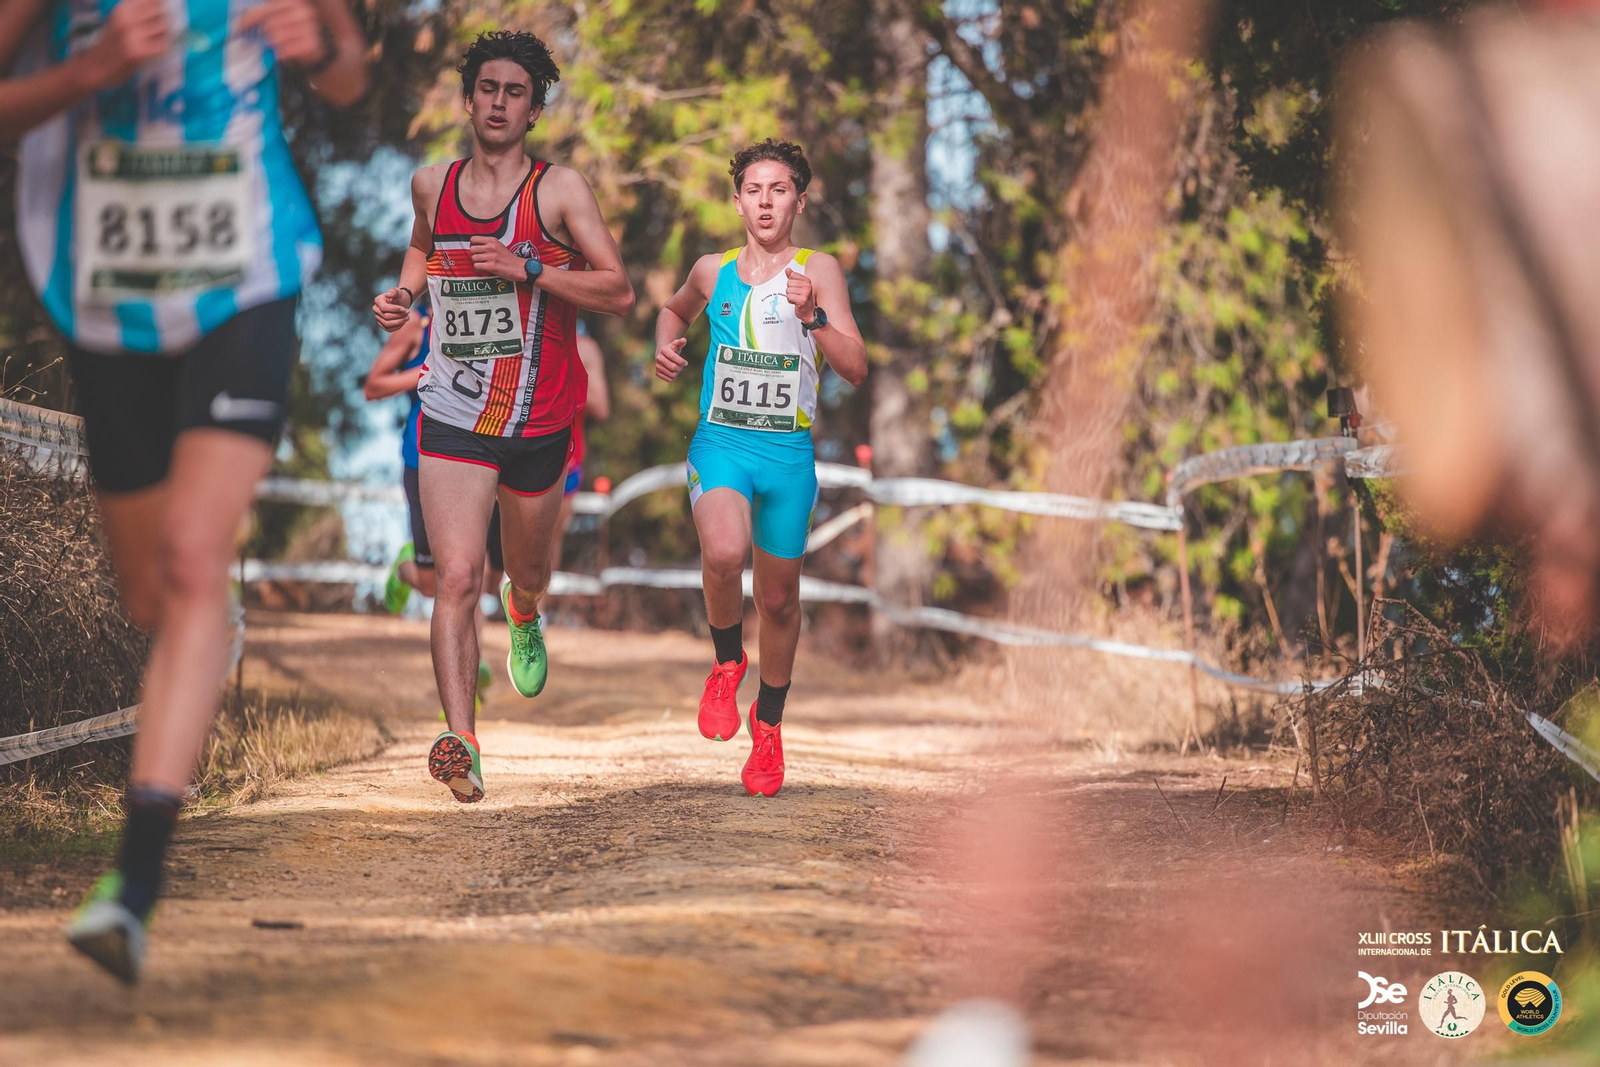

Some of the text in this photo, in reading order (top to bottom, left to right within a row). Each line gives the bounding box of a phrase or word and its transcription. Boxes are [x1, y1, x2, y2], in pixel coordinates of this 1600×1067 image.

[100, 202, 237, 255] 8158
[452, 281, 492, 292] ITÁLICA
[445, 307, 514, 337] 8173
[738, 351, 778, 365] ITÁLICA
[520, 405, 530, 422] CLUB
[525, 366, 538, 403] ATLETISME
[721, 377, 791, 409] 6115
